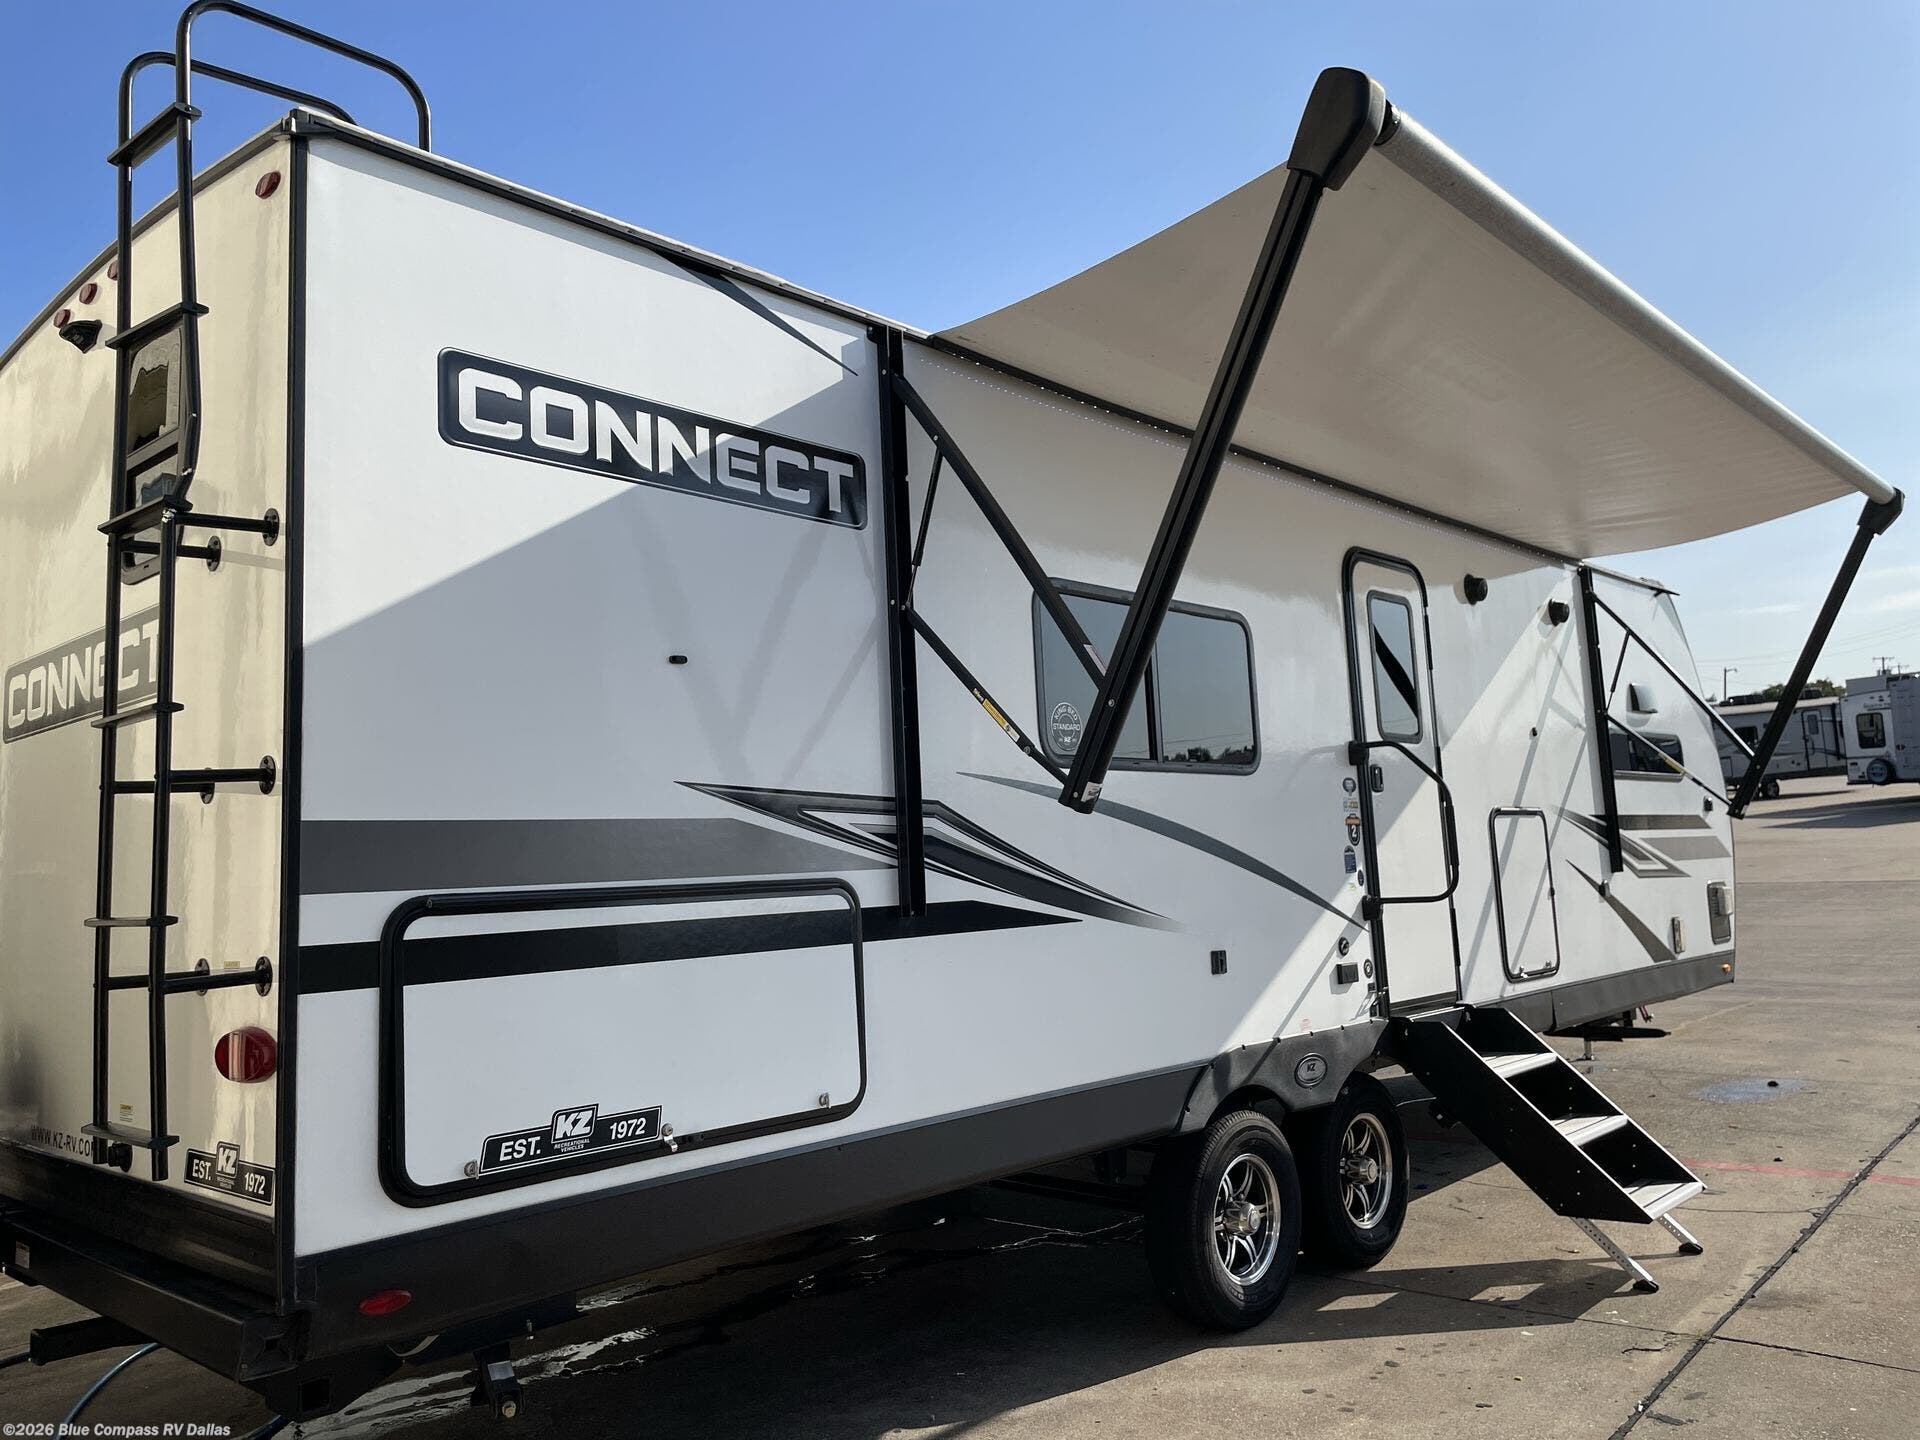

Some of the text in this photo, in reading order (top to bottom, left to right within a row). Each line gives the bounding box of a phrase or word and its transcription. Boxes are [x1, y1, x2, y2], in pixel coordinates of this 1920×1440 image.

[458, 366, 854, 514] CONNECT
[1052, 723, 1081, 731] STANDARD
[1054, 705, 1078, 721] KING BED
[554, 1109, 593, 1139] KZ
[31, 1124, 94, 1158] WWW.KZ-RV.CO
[499, 1117, 647, 1162] EST. 1972
[553, 1138, 590, 1150] RECREATIONAL
[560, 1143, 585, 1153] VEHICLES
[217, 1147, 237, 1175] KZ
[192, 1158, 212, 1181] EST.
[244, 1172, 266, 1195] 1972
